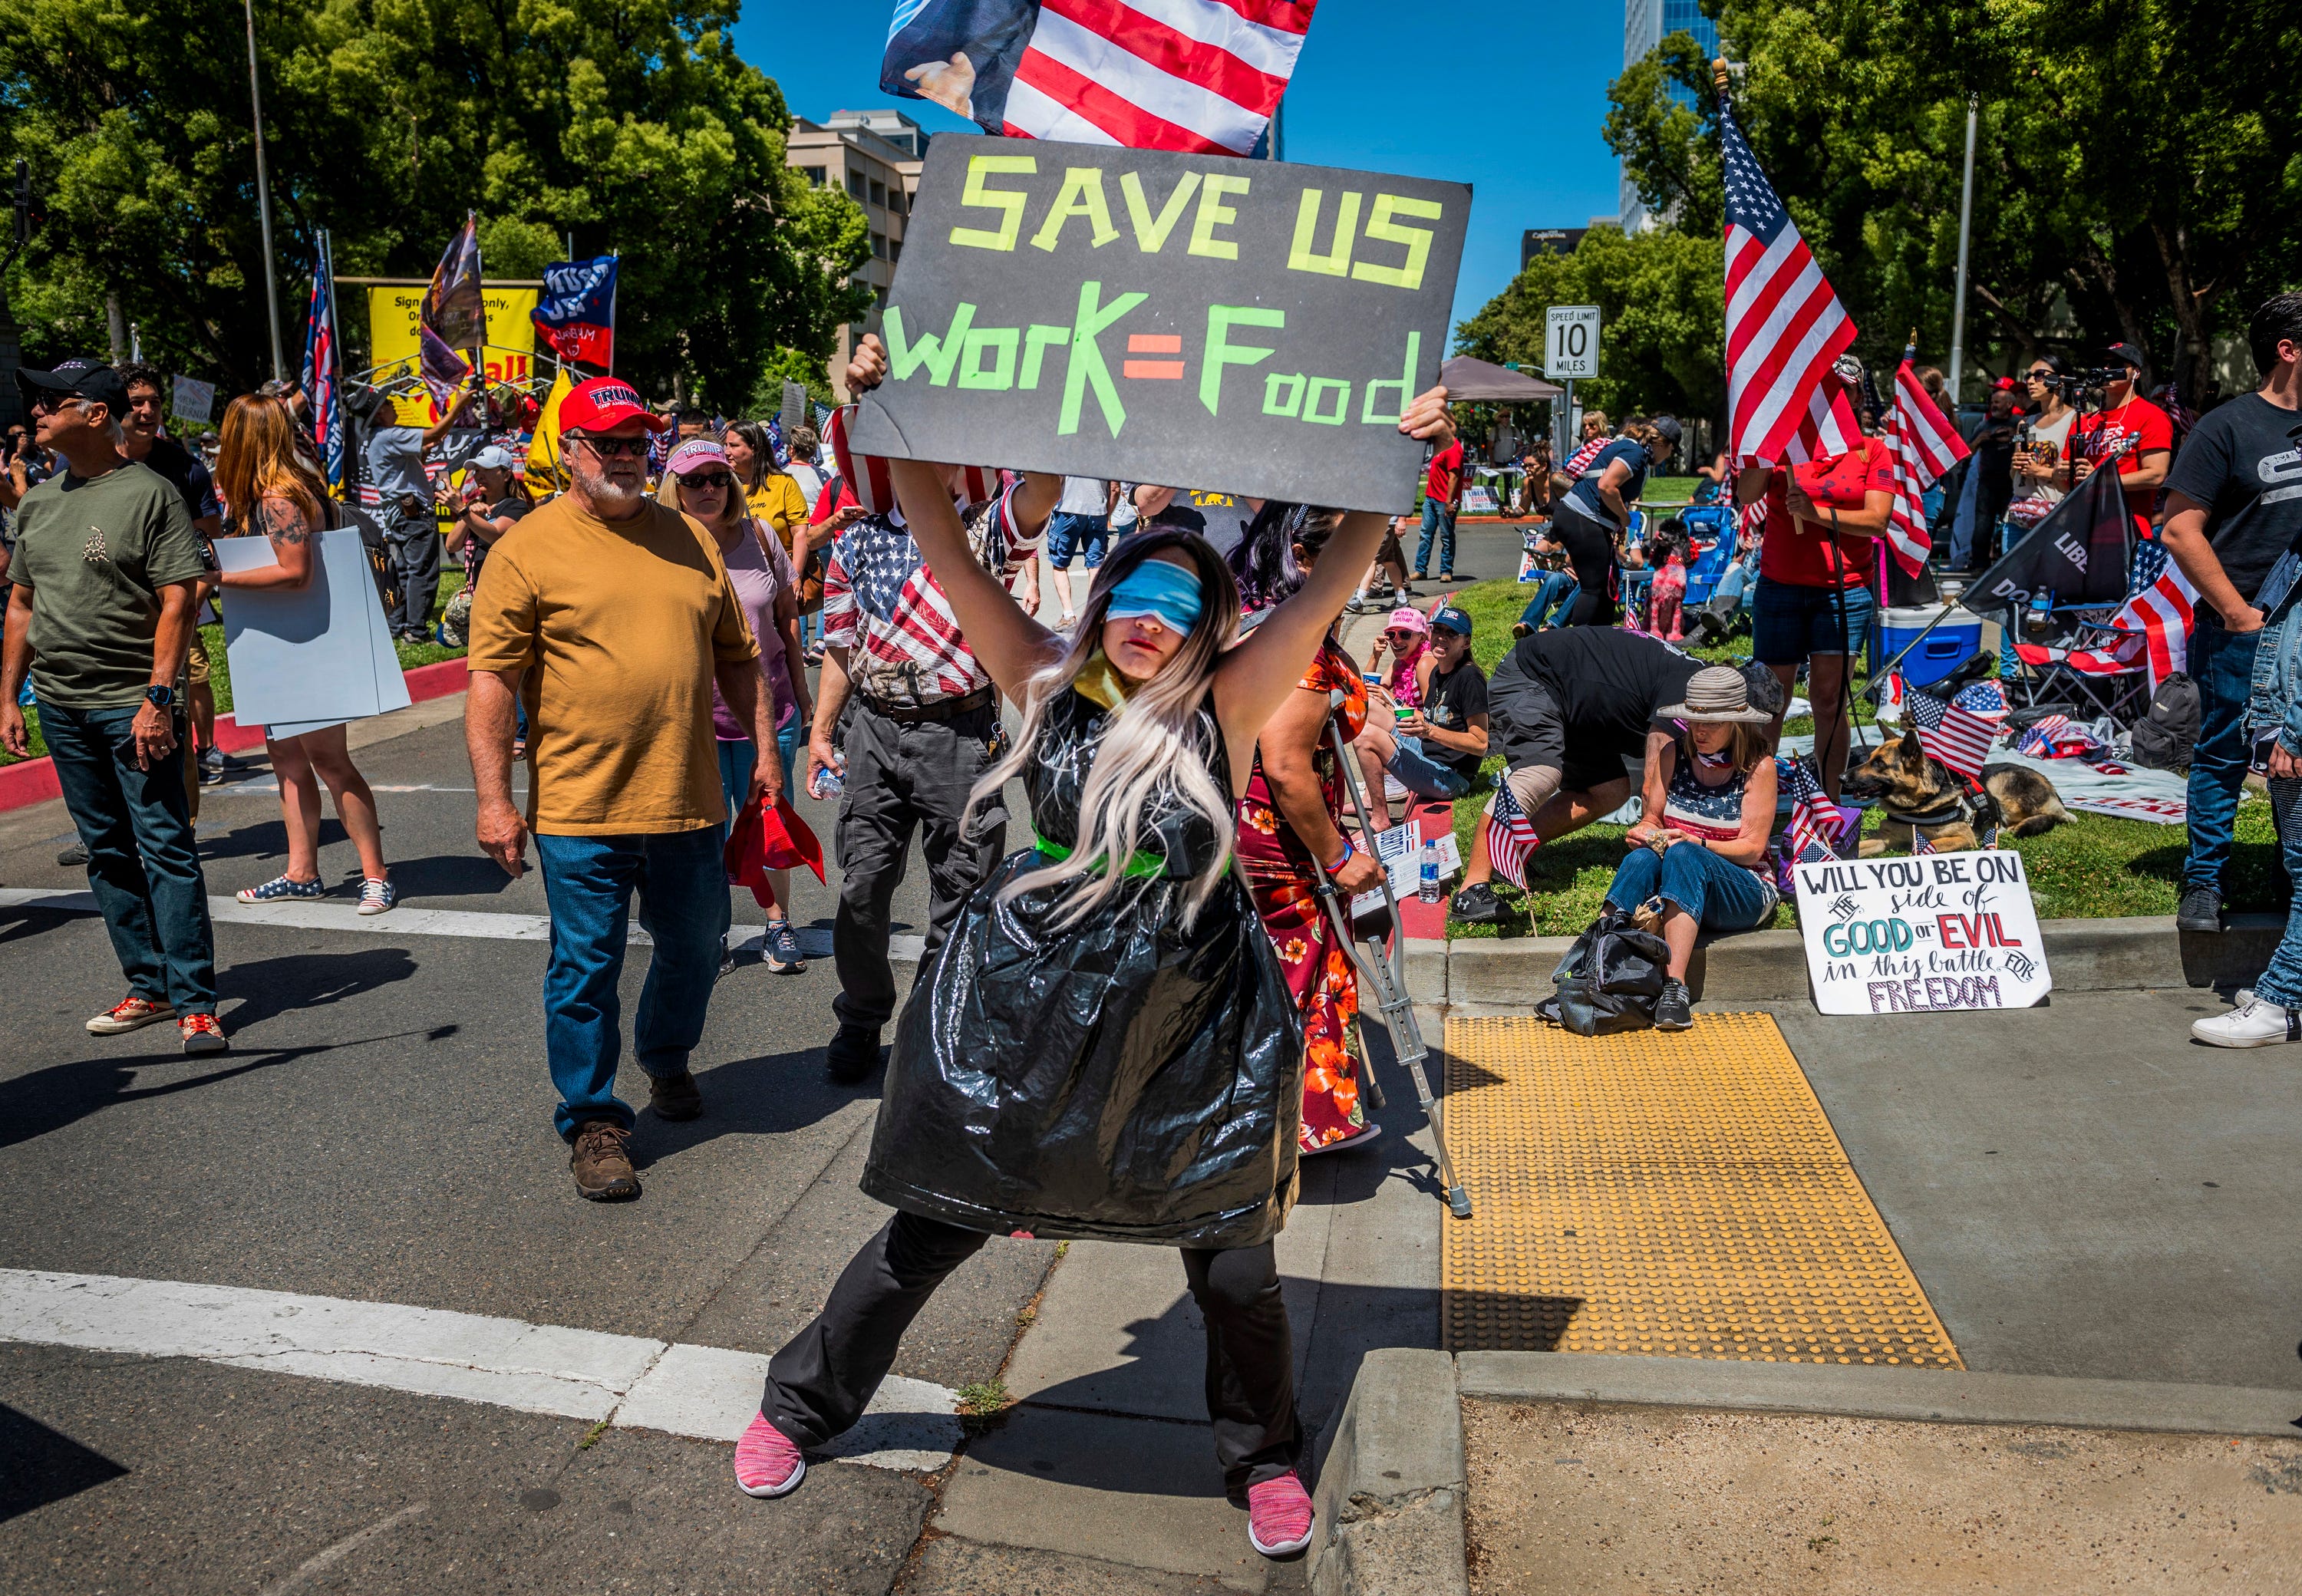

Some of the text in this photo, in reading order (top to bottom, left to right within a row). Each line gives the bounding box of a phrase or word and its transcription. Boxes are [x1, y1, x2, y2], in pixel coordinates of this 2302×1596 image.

[948, 155, 1443, 290] SAVE US
[394, 296, 419, 308] Sign
[1551, 312, 1595, 322] SPEED LIMIT
[1558, 323, 1587, 357] 10
[1557, 361, 1585, 371] MILES
[684, 444, 722, 457] TRUMP
[1801, 856, 2020, 895] WILL YOU BE ON
[1829, 883, 1999, 920] THE side of
[1823, 912, 2022, 958] GOOD or EVIL
[1823, 949, 2034, 982] in this battle FOR
[1867, 975, 2002, 1013] FREEDOM
